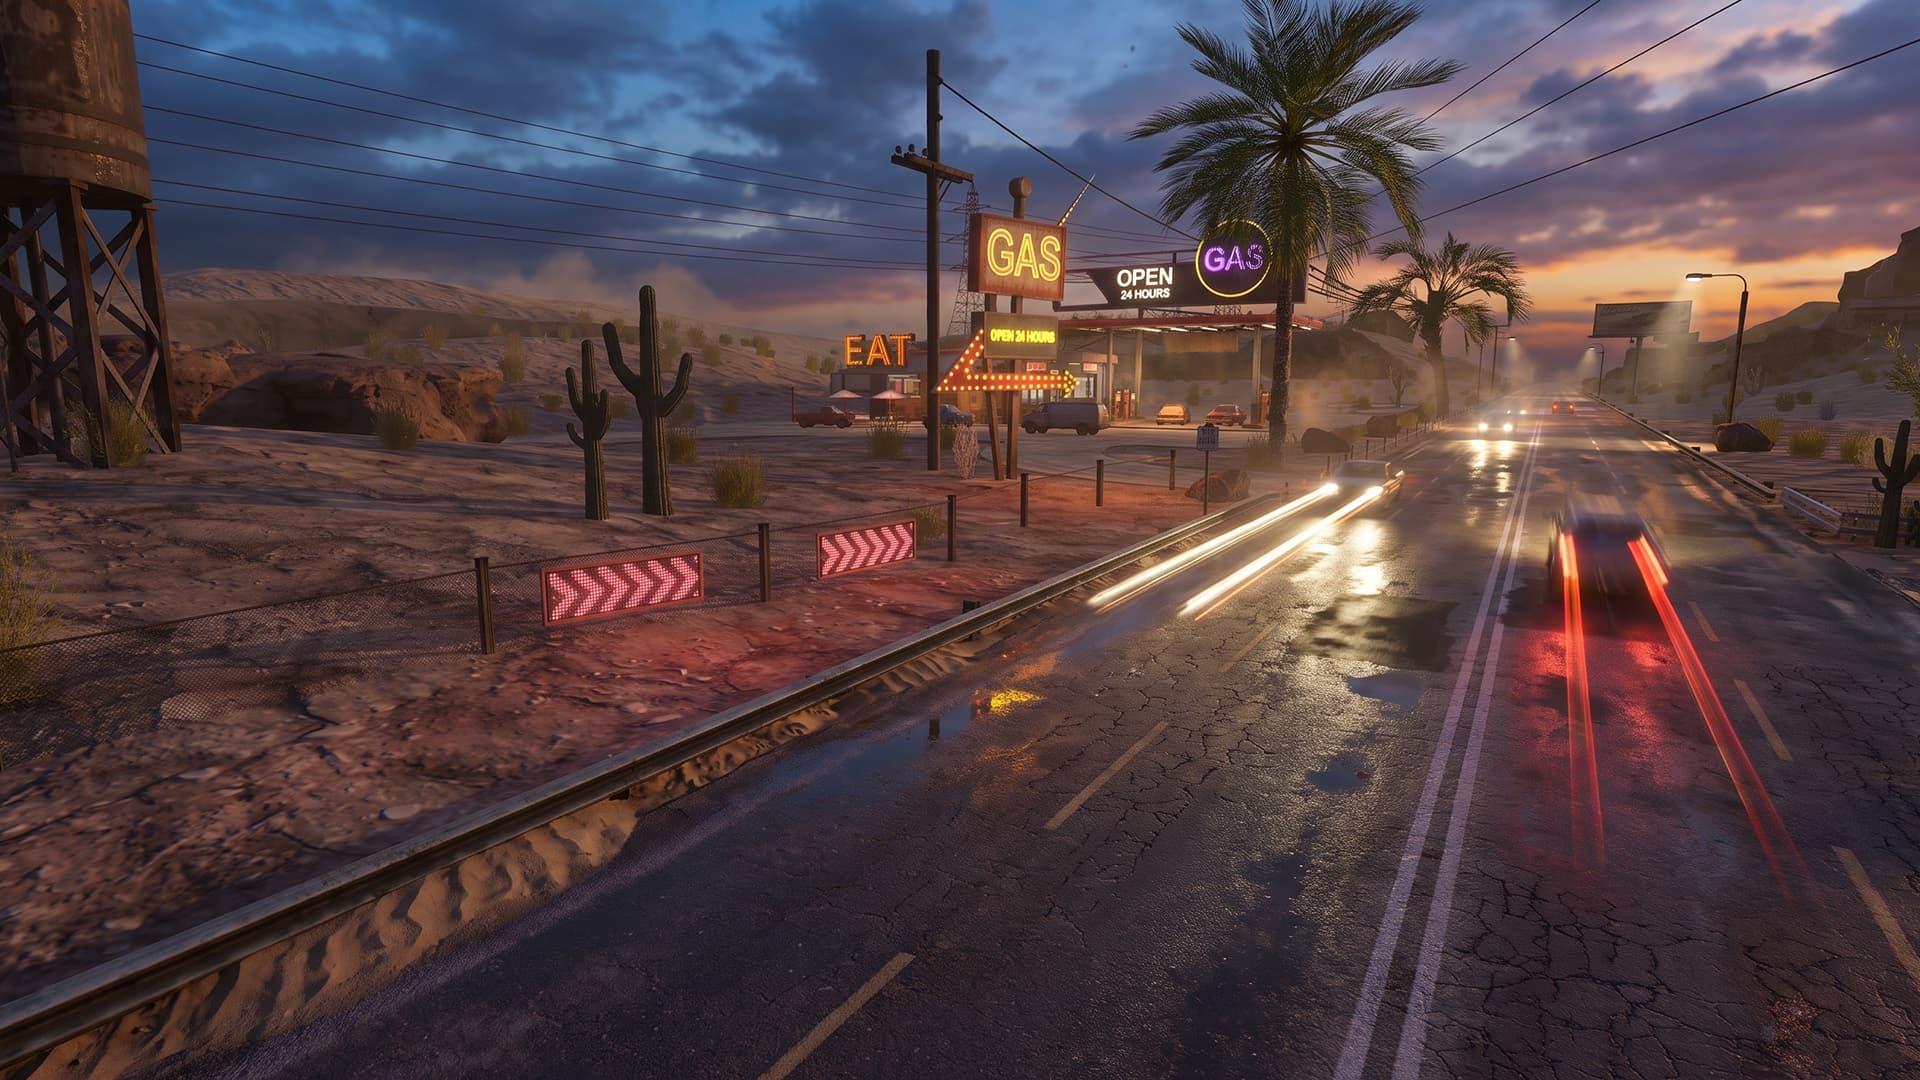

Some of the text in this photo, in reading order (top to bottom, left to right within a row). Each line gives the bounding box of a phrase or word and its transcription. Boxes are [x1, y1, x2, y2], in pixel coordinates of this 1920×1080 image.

[987, 228, 1061, 281] GAS
[1204, 244, 1264, 272] GAS
[1117, 267, 1173, 287] OPEN
[1120, 288, 1170, 300] 24 HOURS
[991, 329, 1056, 344] OPEN 24 HOURS
[844, 334, 914, 367] EAT
